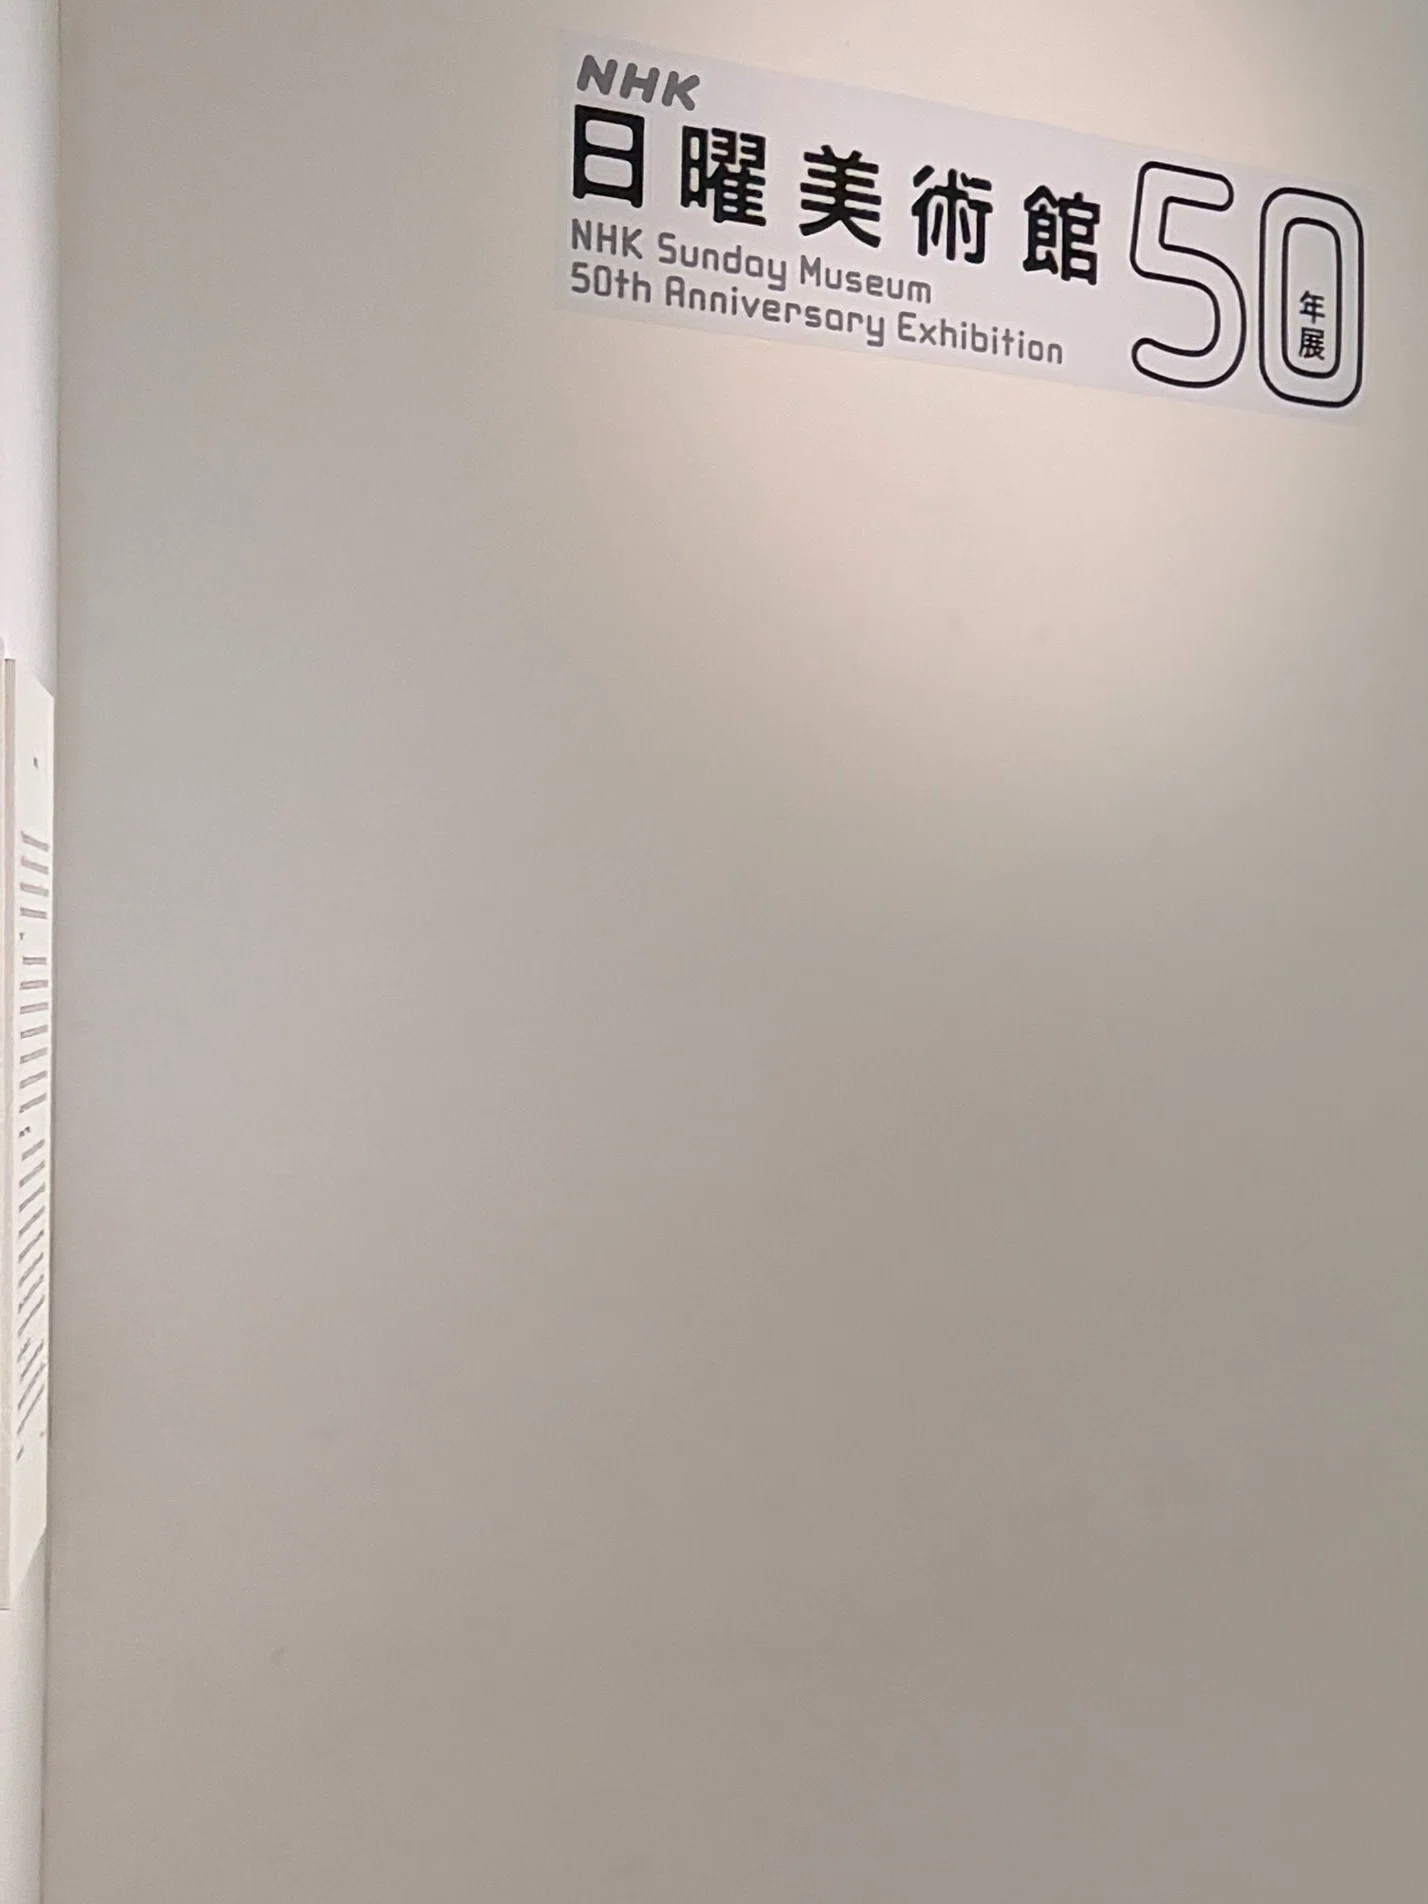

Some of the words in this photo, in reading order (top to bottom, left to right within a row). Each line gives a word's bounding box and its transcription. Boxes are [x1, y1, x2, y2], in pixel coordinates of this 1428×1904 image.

[576, 54, 700, 111] NHK
[572, 103, 1100, 286] 日曜美術館
[571, 218, 643, 259] NHK
[658, 232, 786, 292] Sunday
[800, 254, 932, 304] Museum
[1130, 160, 1364, 408] 50
[571, 262, 651, 303] 50th
[665, 275, 884, 348] Anniversary
[898, 311, 1063, 365] Exhibition
[1299, 290, 1326, 361] 年展
